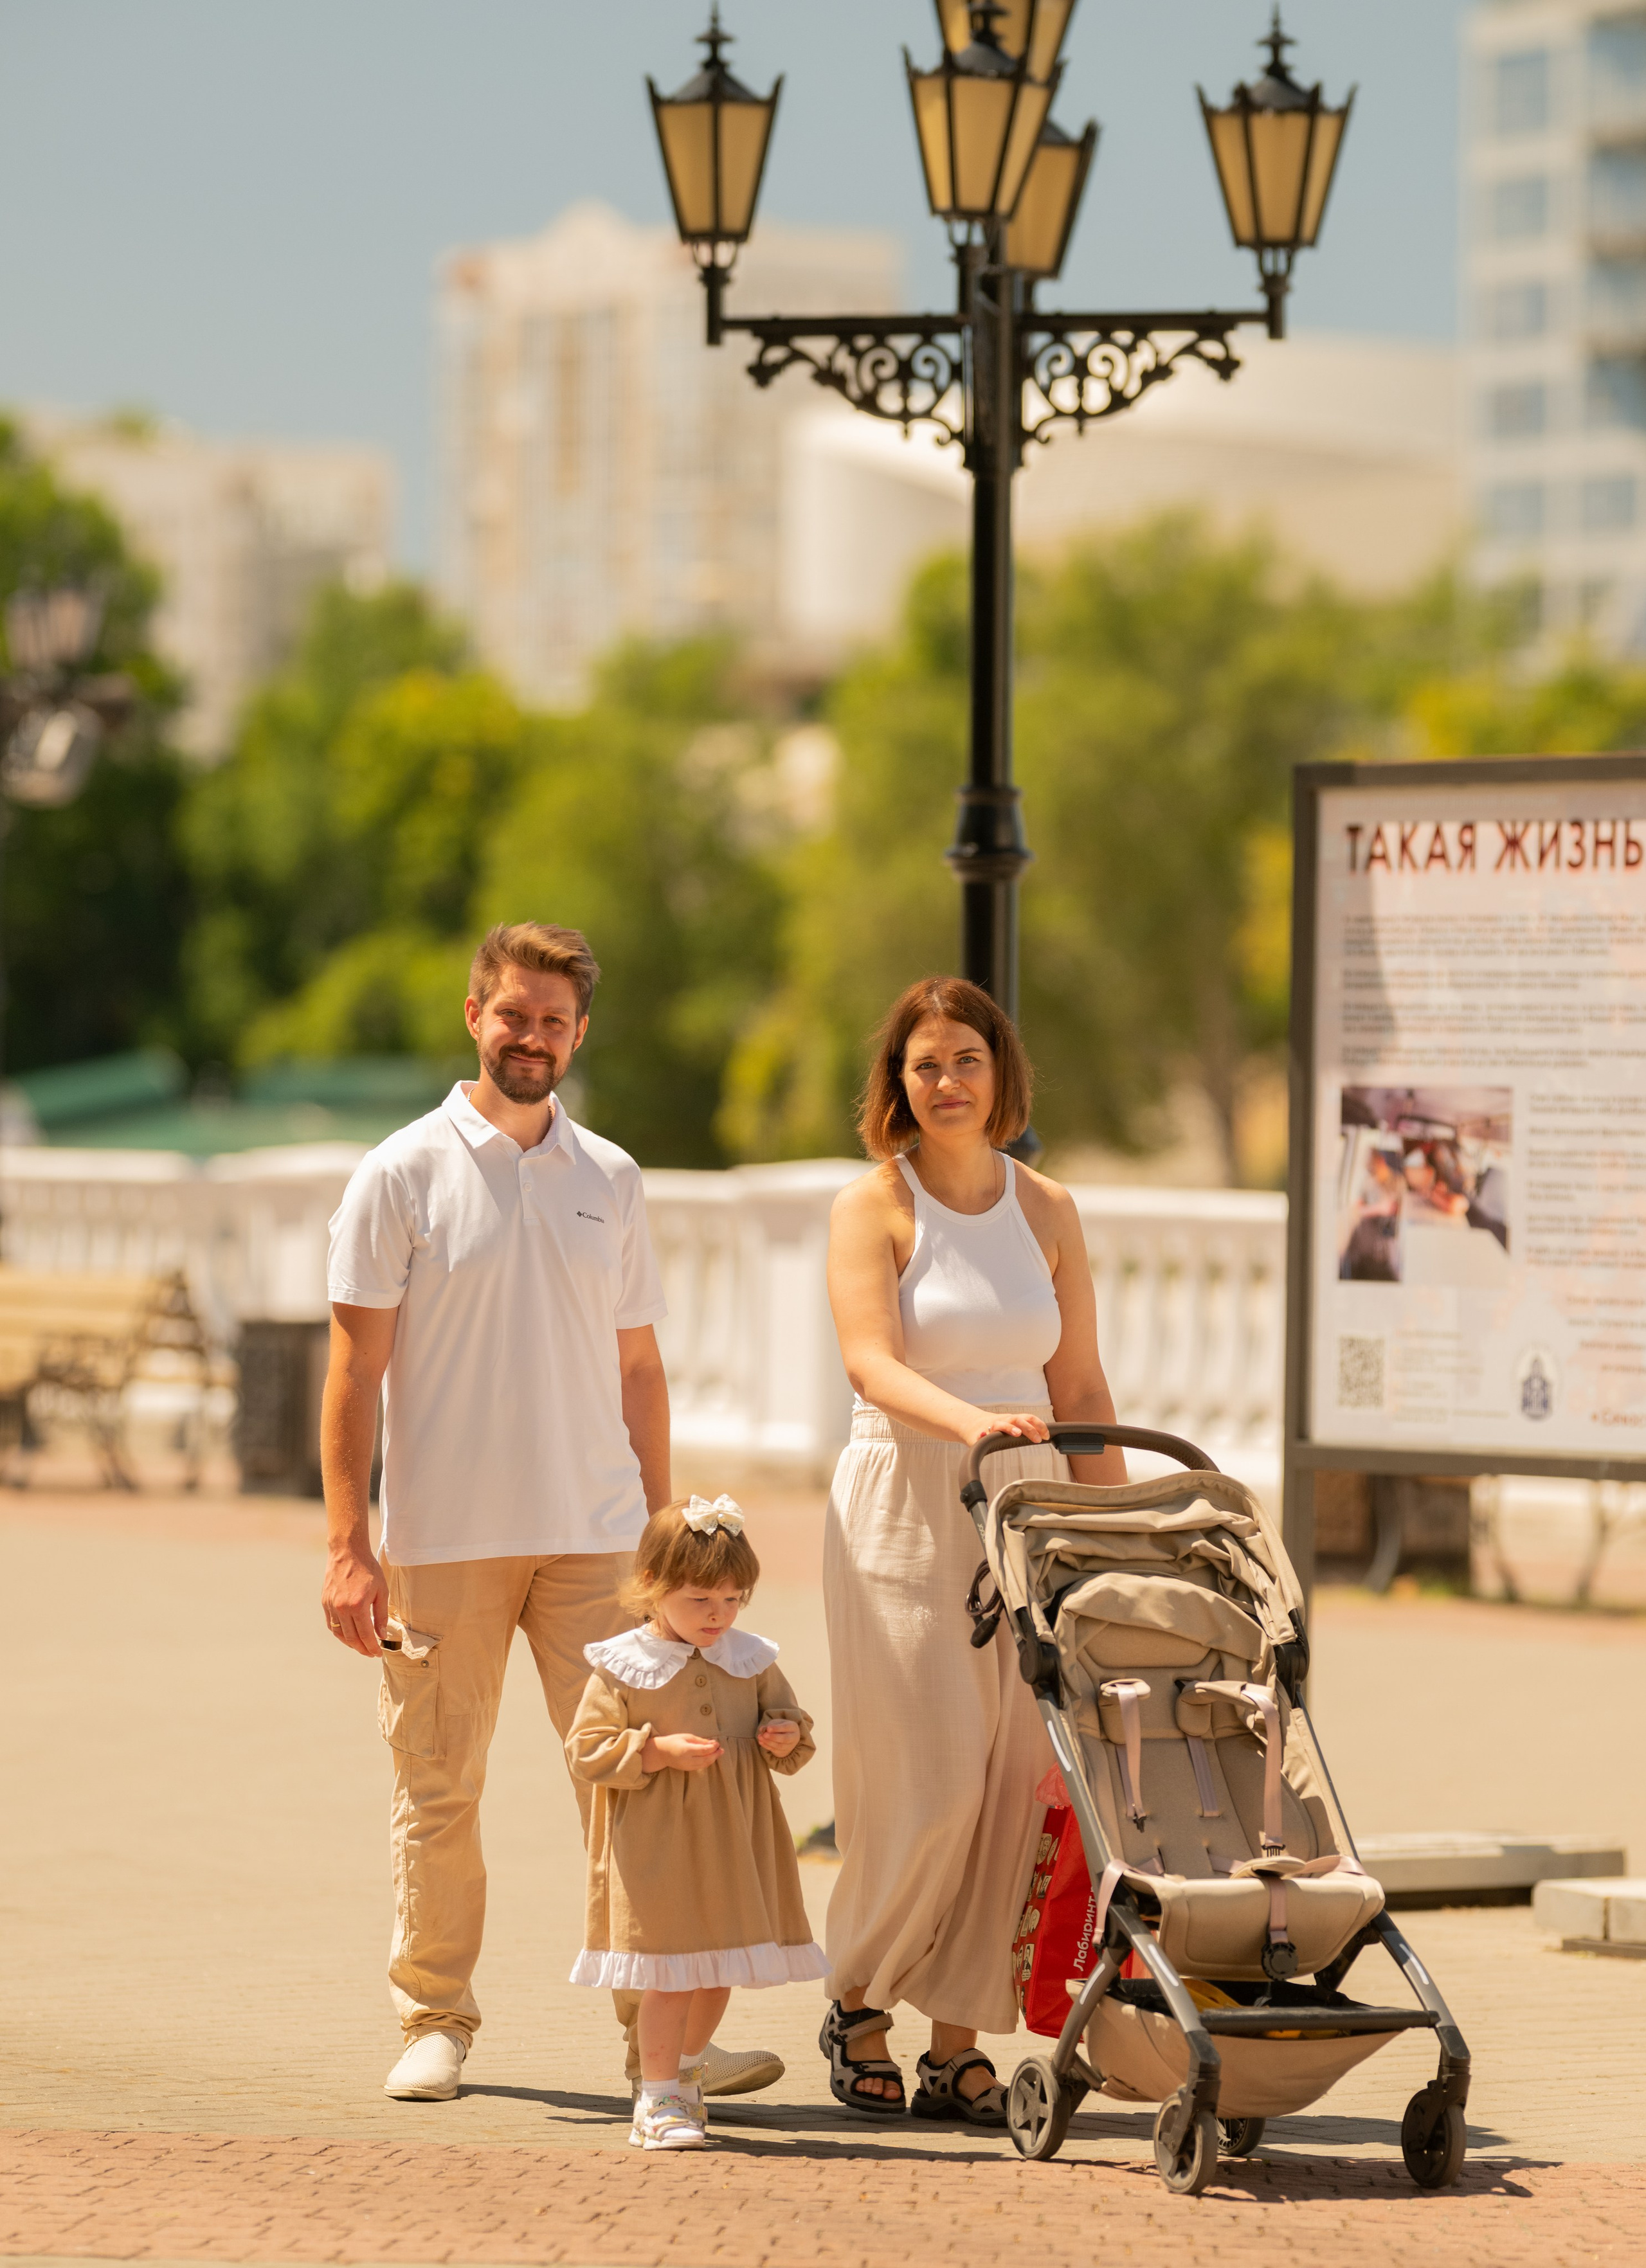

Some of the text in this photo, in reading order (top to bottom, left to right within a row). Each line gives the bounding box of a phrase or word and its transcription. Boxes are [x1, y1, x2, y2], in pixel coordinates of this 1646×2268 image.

[1346, 819, 1644, 872] ТАКАЯ ЖИЗНЬ
[582, 1212, 604, 1223] Columbia
